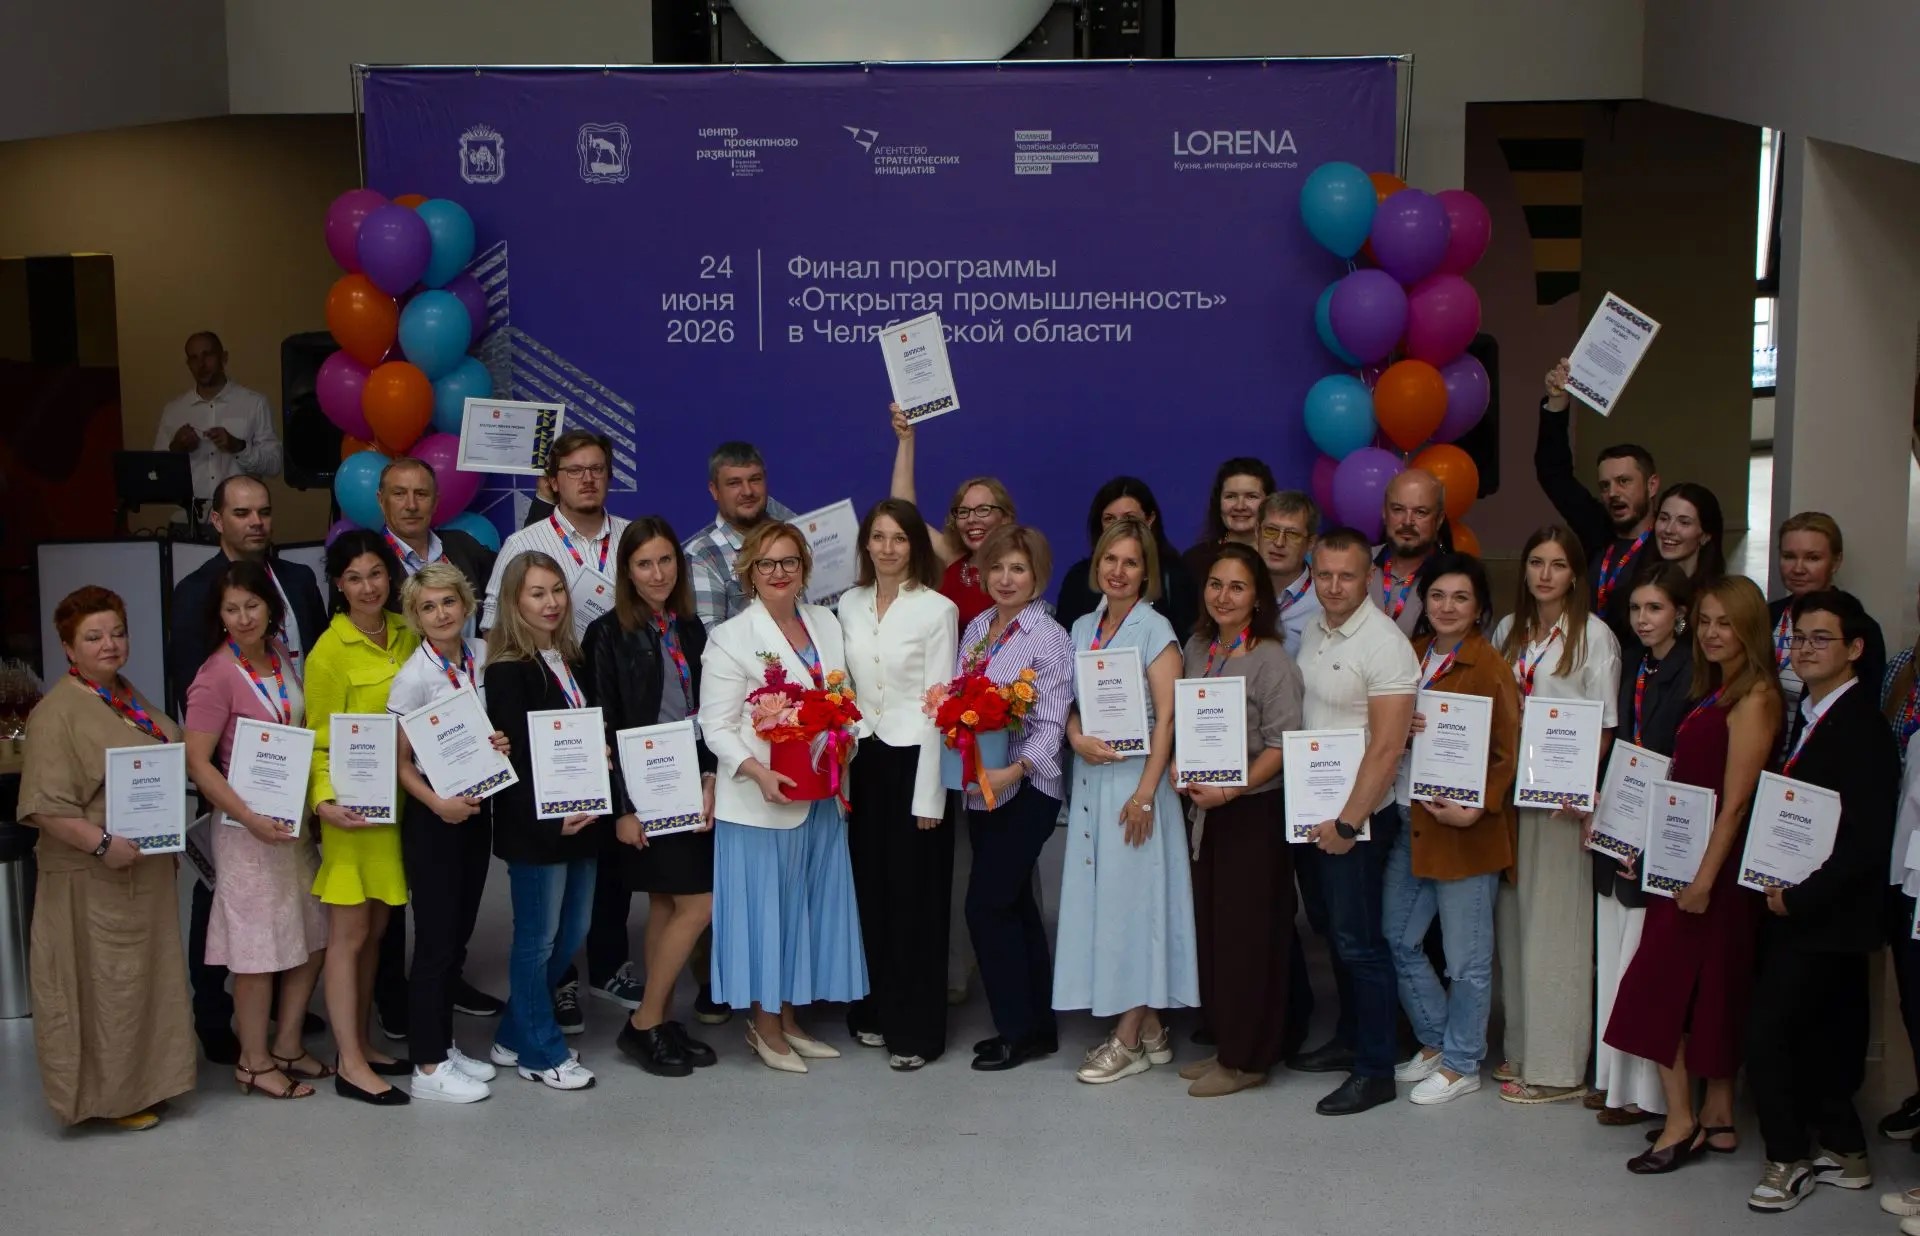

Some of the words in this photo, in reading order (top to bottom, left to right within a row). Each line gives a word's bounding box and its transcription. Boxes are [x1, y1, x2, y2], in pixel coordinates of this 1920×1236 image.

[698, 127, 738, 138] центр
[723, 138, 798, 148] проектного
[1016, 142, 1067, 151] Челябинской
[1067, 142, 1099, 150] области
[1174, 130, 1298, 155] LORENA
[696, 149, 756, 160] развития
[874, 146, 928, 155] АГЕНТСТВО
[874, 156, 960, 165] СТРАТЕГИЧЕСКИХ
[1027, 153, 1094, 162] промышленному
[875, 166, 936, 176] ИНИЦИАТИВ
[1016, 165, 1050, 173] туризму
[1174, 161, 1202, 172] Кухни,
[1204, 161, 1253, 171] интерьеры
[1255, 161, 1261, 169] и
[1262, 161, 1298, 169] счастье
[700, 255, 734, 279] 24
[788, 255, 880, 279] Финал
[890, 259, 1057, 284] программы
[662, 293, 734, 311] июня
[788, 287, 943, 316] «Открытая
[954, 290, 1227, 316] промышленность»
[667, 319, 735, 343] 2026
[789, 325, 804, 343] в
[813, 318, 1004, 343] Челяской
[1014, 317, 1132, 343] области
[585, 598, 606, 615] ДИПЛО
[1098, 678, 1122, 686] ДИПЛОМ
[1197, 708, 1224, 716] ДИПЛОМ
[437, 723, 466, 741] ДИПЛОМ
[1437, 722, 1467, 732] ДИПЛОМ
[1545, 728, 1577, 737] ДИПЛОМ
[349, 743, 376, 751] ДИПЛОМ
[554, 739, 582, 747] ДИПЛОМ
[256, 751, 287, 762] ДИПЛОМ
[646, 755, 675, 767] ДИПЛОМ
[1310, 760, 1341, 769] ДИПЛОМ
[132, 777, 161, 785] ДИПЛОМ
[1624, 775, 1647, 788] ДИПЛОМ
[1666, 814, 1690, 826] ДИПЛОМ
[1779, 810, 1812, 825] ДИПЛОМ
